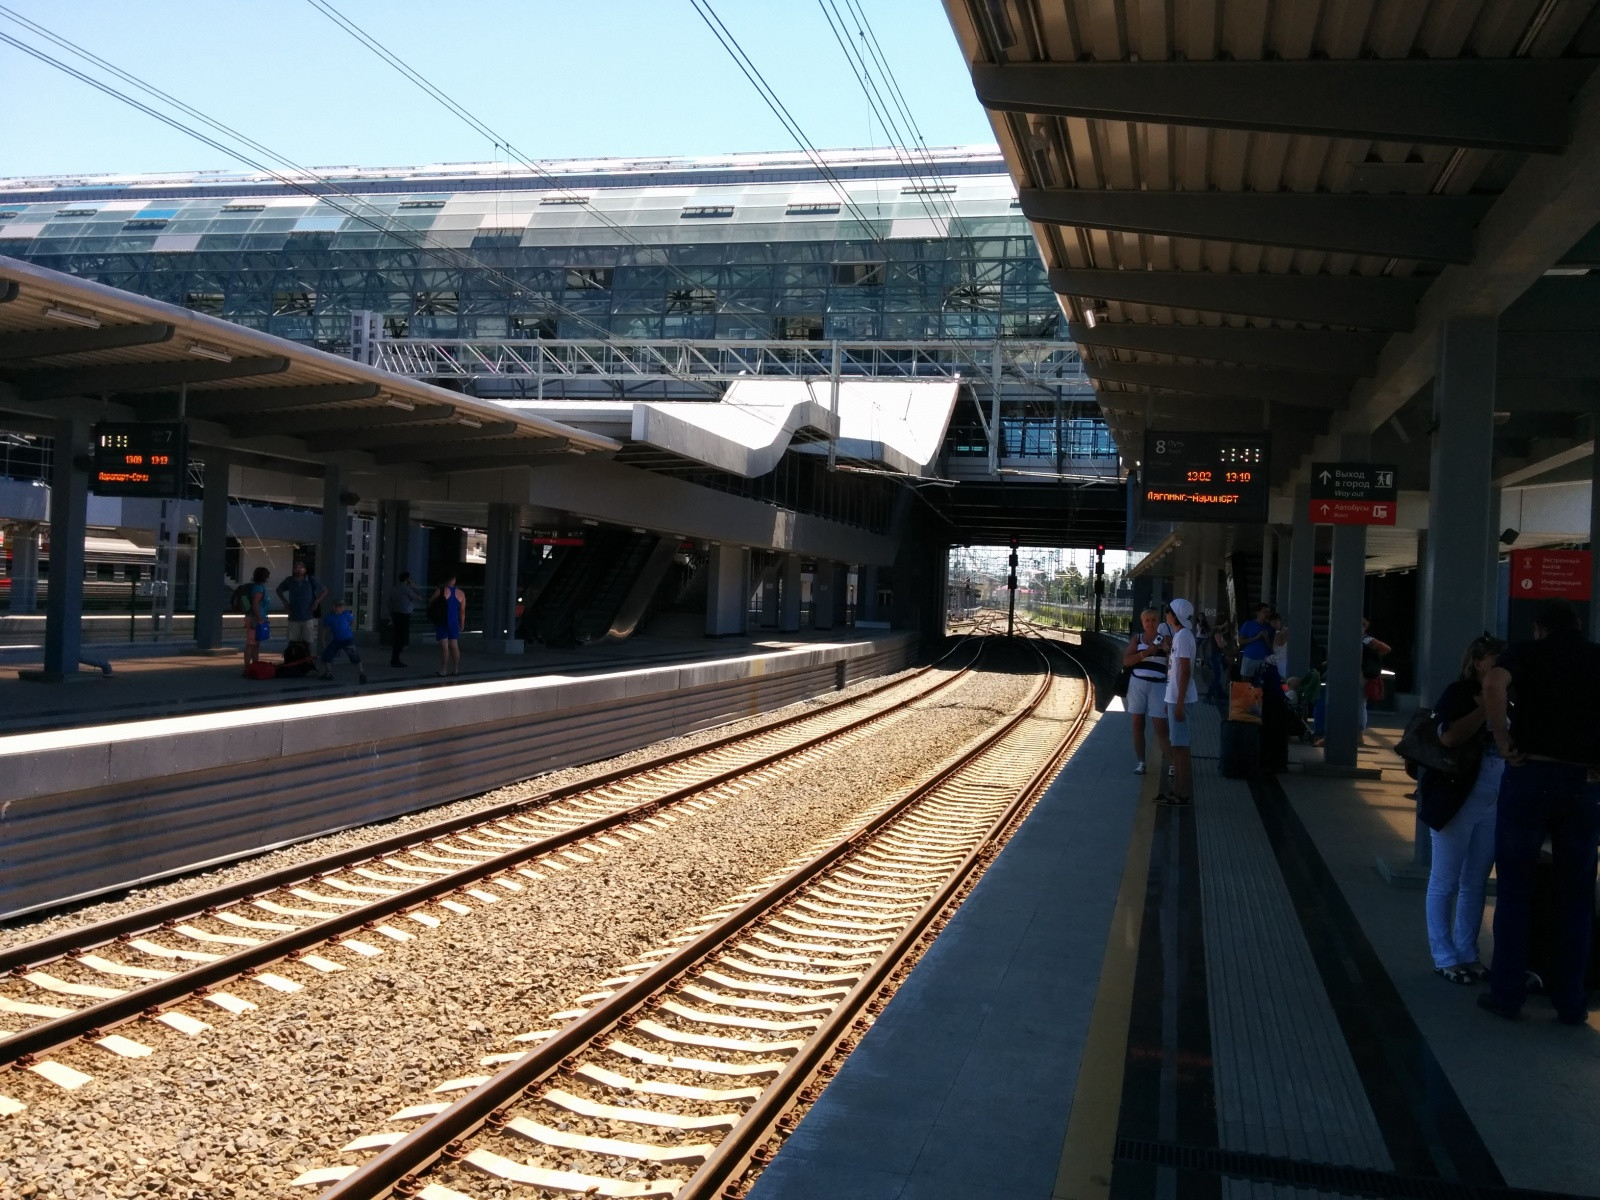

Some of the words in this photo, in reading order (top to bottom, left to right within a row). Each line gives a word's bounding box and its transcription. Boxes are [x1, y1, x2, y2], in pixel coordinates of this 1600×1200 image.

[1155, 440, 1166, 454] 8
[1335, 470, 1365, 479] Выход
[1342, 481, 1370, 489] город
[1334, 490, 1350, 498] Way
[1334, 504, 1370, 512] Автобусы
